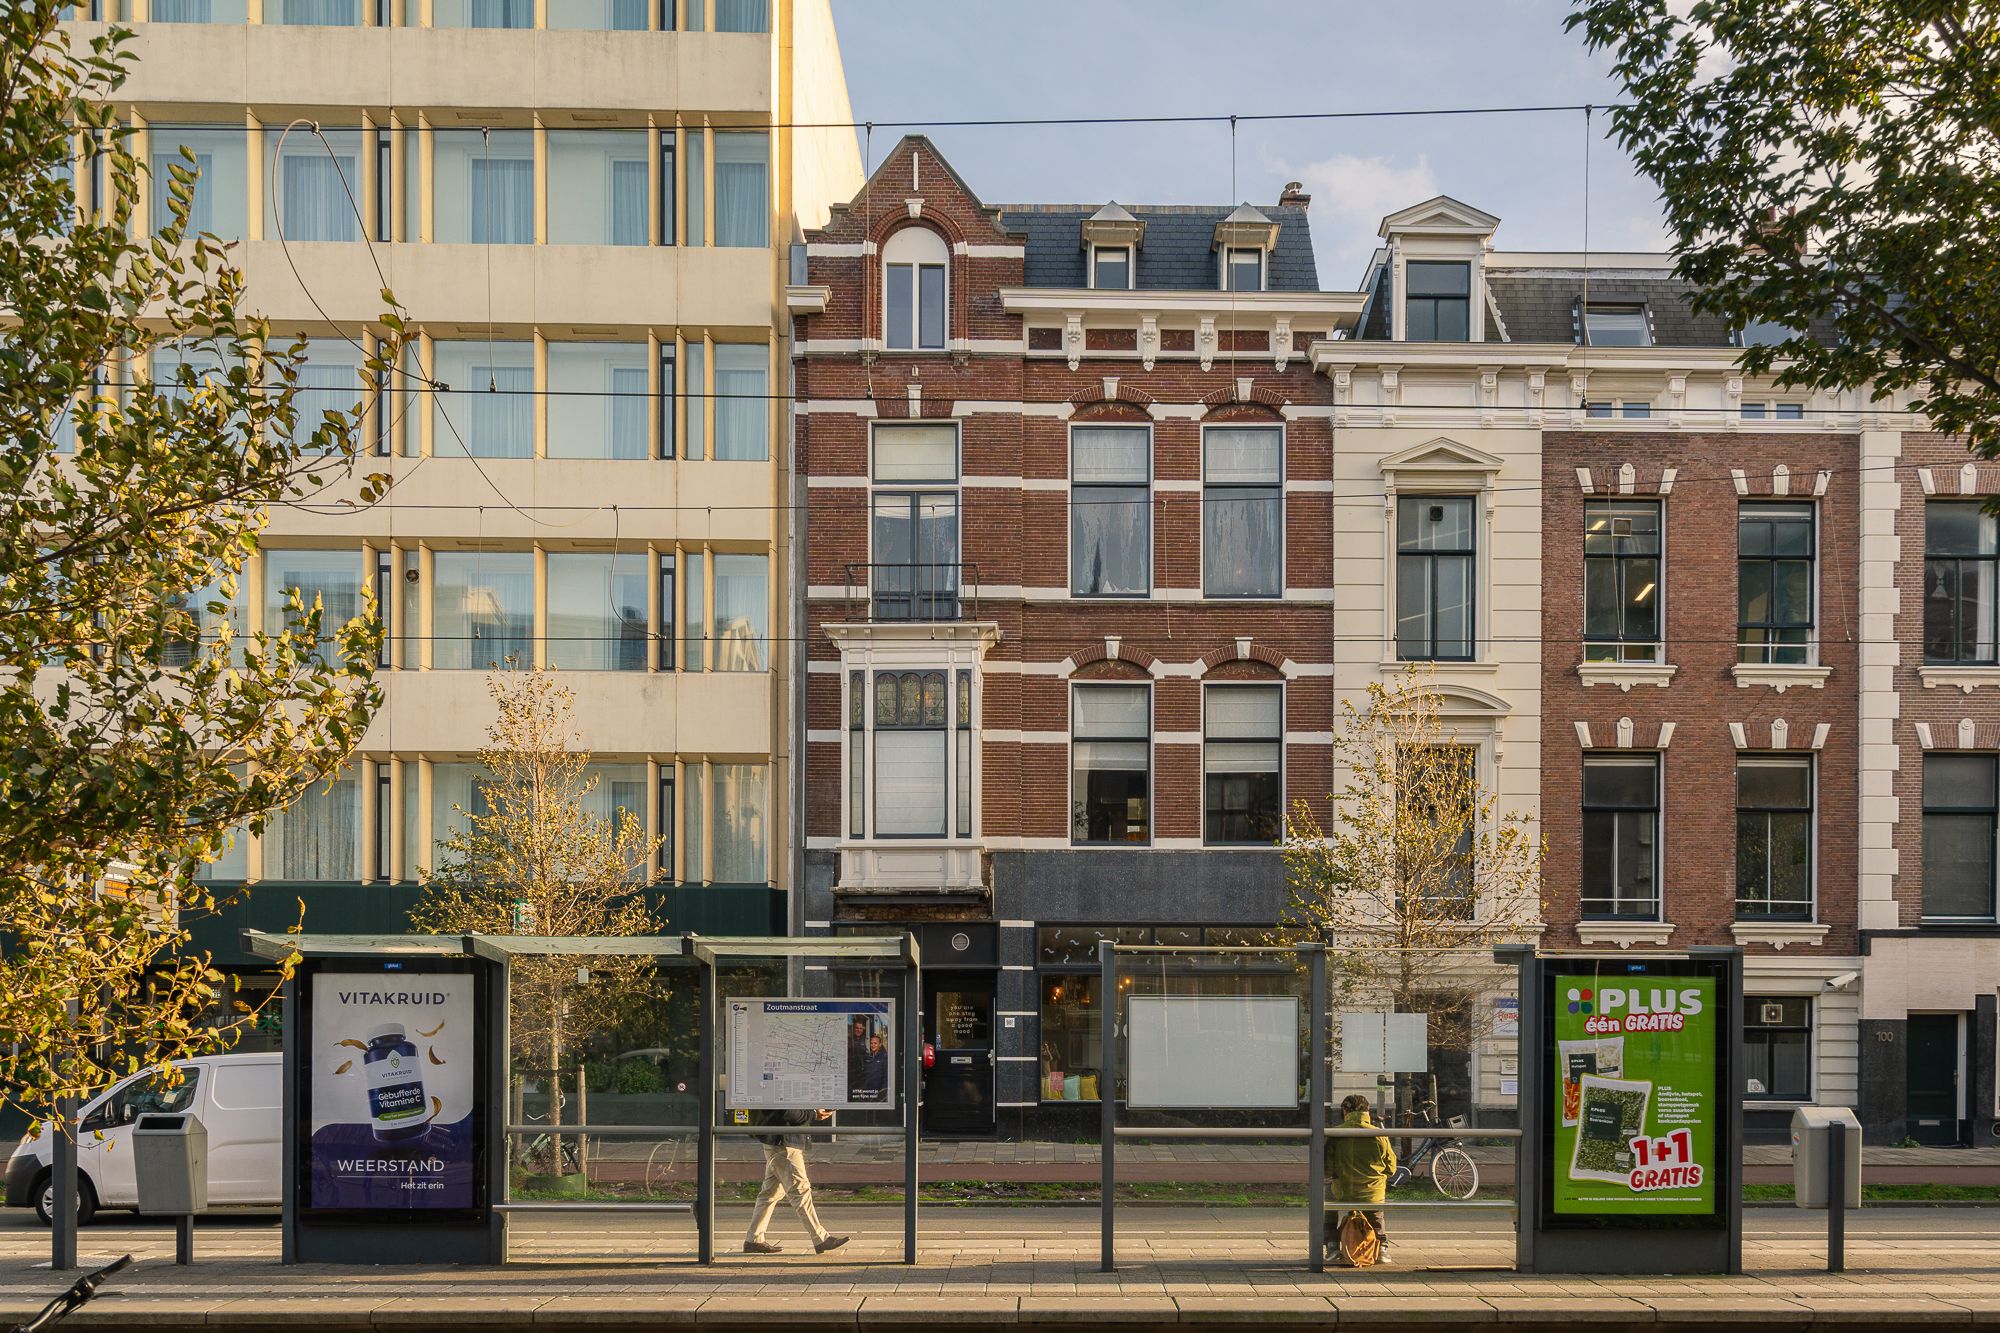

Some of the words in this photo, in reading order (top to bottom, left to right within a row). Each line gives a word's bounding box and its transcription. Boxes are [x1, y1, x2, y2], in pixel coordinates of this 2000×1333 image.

[1600, 988, 1703, 1015] PLUS
[1585, 1017, 1620, 1034] één
[1625, 1014, 1684, 1031] GRATIS
[1876, 1031, 1894, 1042] 100
[381, 1070, 413, 1078] VITAKRUID
[378, 1087, 421, 1101] Gebufferde
[379, 1097, 415, 1109] Vitamine
[1633, 1132, 1689, 1166] 1+1
[337, 1159, 445, 1172] WEERSTAND
[1630, 1166, 1701, 1188] GRATIS
[400, 1181, 415, 1190] Het
[417, 1181, 427, 1190] zit
[428, 1181, 445, 1190] erin
